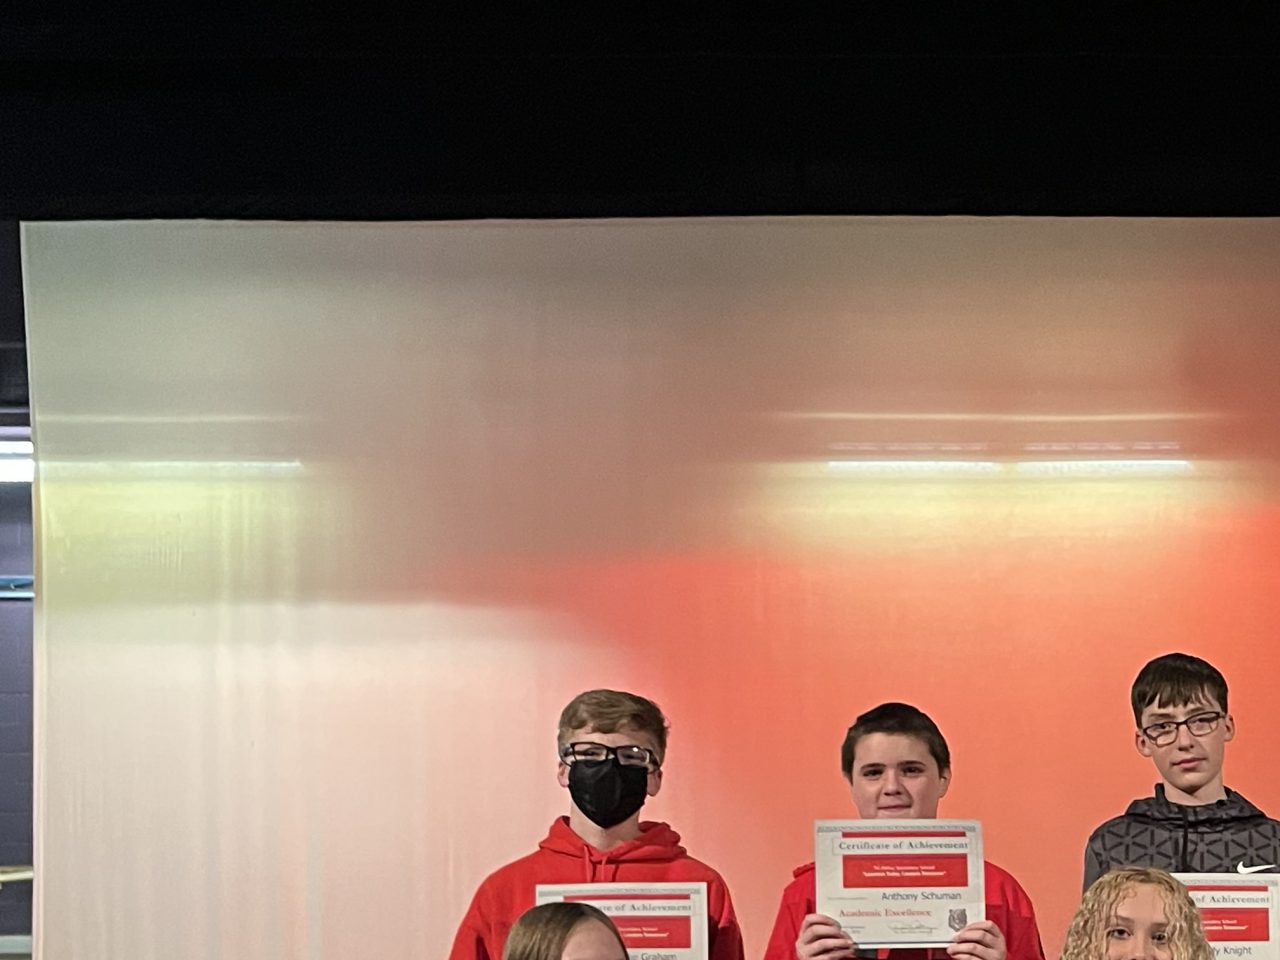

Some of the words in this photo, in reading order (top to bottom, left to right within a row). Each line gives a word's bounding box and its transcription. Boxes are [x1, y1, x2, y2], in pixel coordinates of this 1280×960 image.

[839, 842, 889, 850] Certificate
[907, 841, 968, 849] Achievement
[882, 892, 917, 901] Anthony
[922, 892, 961, 900] Schuman
[631, 904, 691, 912] Achievement
[839, 909, 882, 917] Academic
[885, 909, 932, 917] Excellence
[1224, 946, 1251, 955] Knight
[641, 953, 677, 960] Graham
